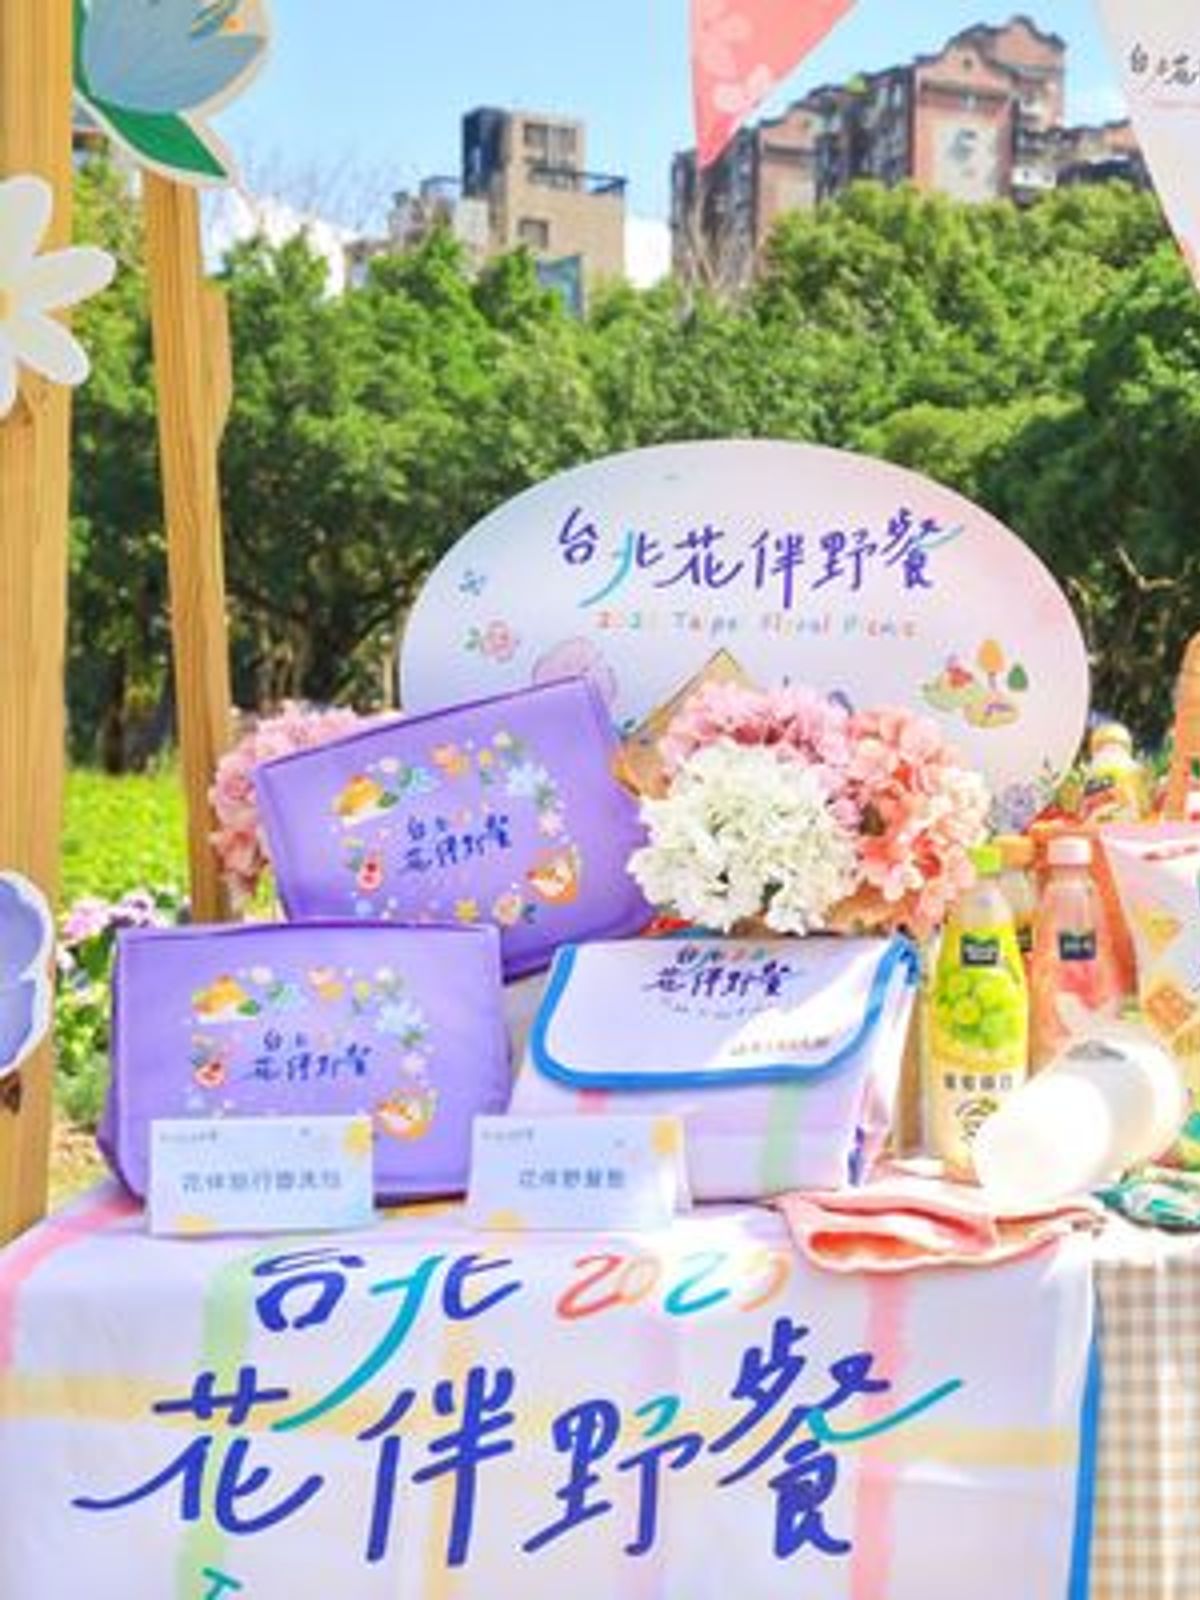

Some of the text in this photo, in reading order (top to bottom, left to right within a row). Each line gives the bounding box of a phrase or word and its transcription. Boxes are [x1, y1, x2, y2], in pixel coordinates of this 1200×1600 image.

[558, 507, 965, 609] 台北花伴野餐
[252, 1248, 522, 1432] 台北
[73, 1316, 963, 1568] 花伴野餐
